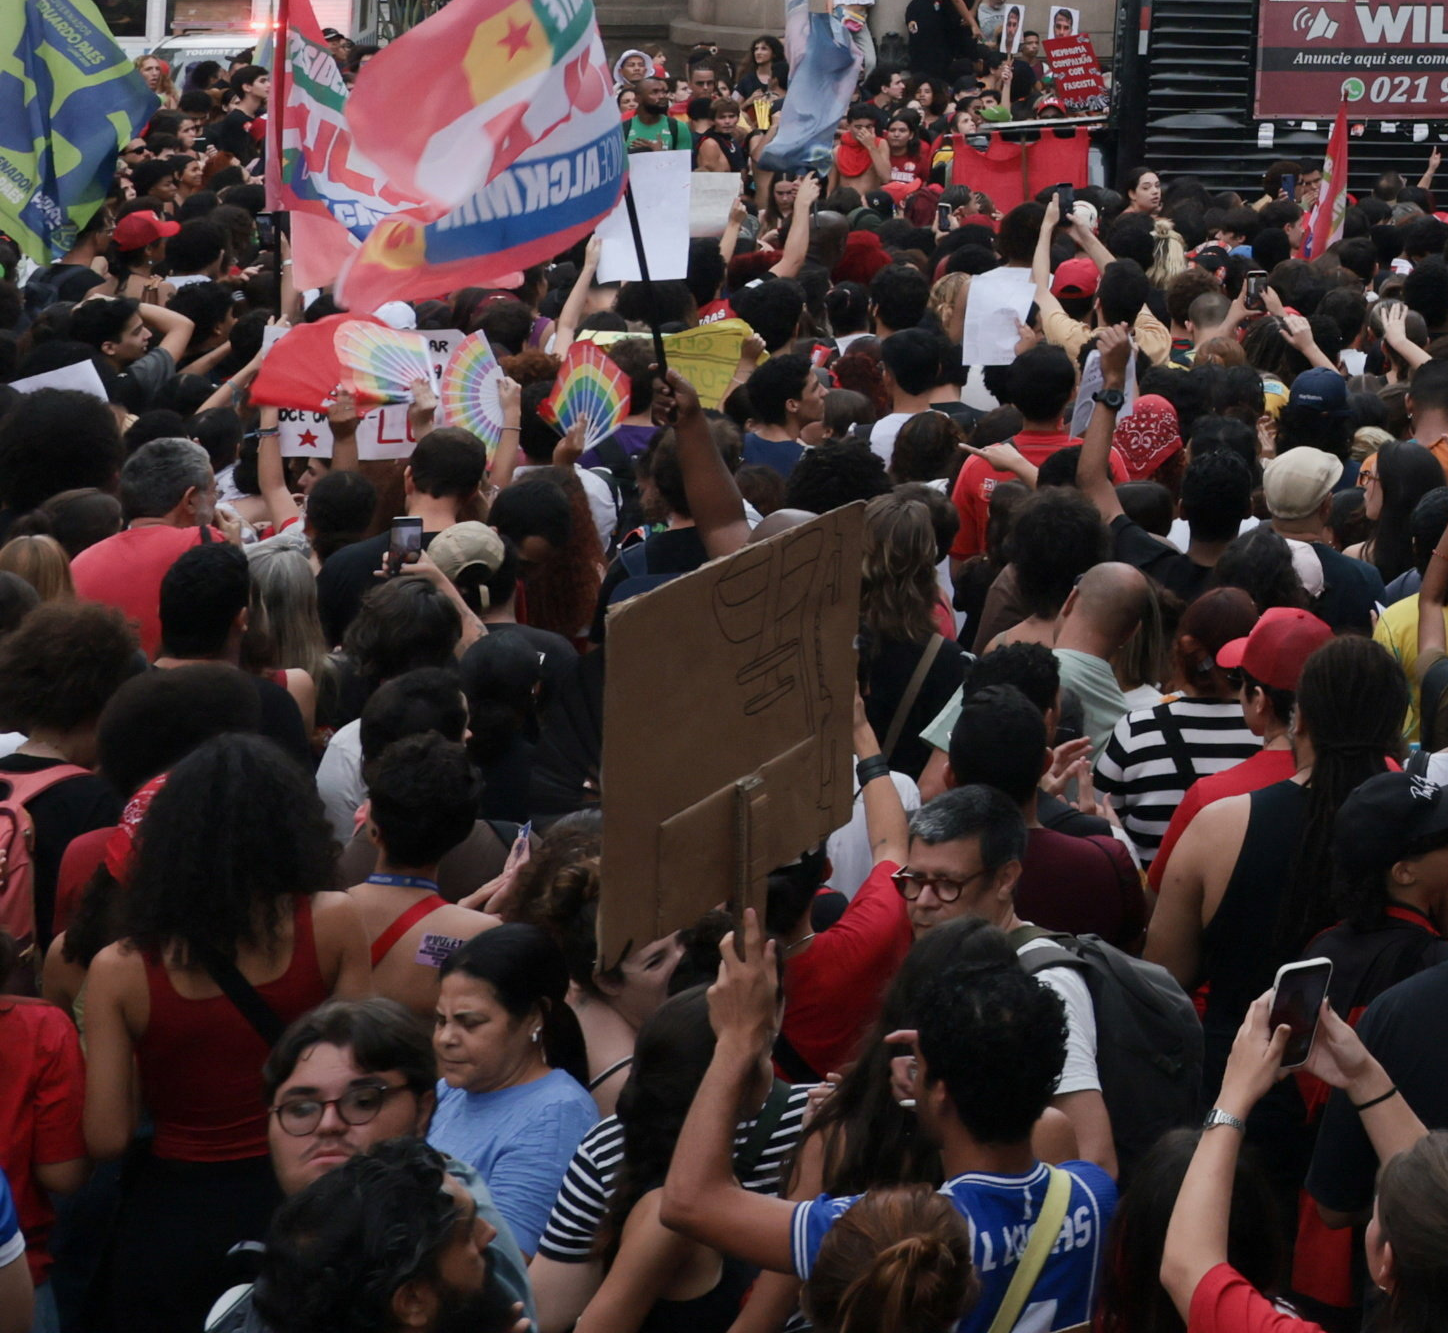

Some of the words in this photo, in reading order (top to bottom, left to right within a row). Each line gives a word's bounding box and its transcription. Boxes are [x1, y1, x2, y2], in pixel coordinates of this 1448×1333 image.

[74, 37, 107, 65] PAES
[185, 48, 232, 57] TOURIST
[1293, 50, 1352, 66] Anuncie
[1353, 52, 1387, 68] aqui
[1389, 53, 1414, 65] seu
[1063, 79, 1097, 91] FASCISTA
[1369, 75, 1428, 103] 021
